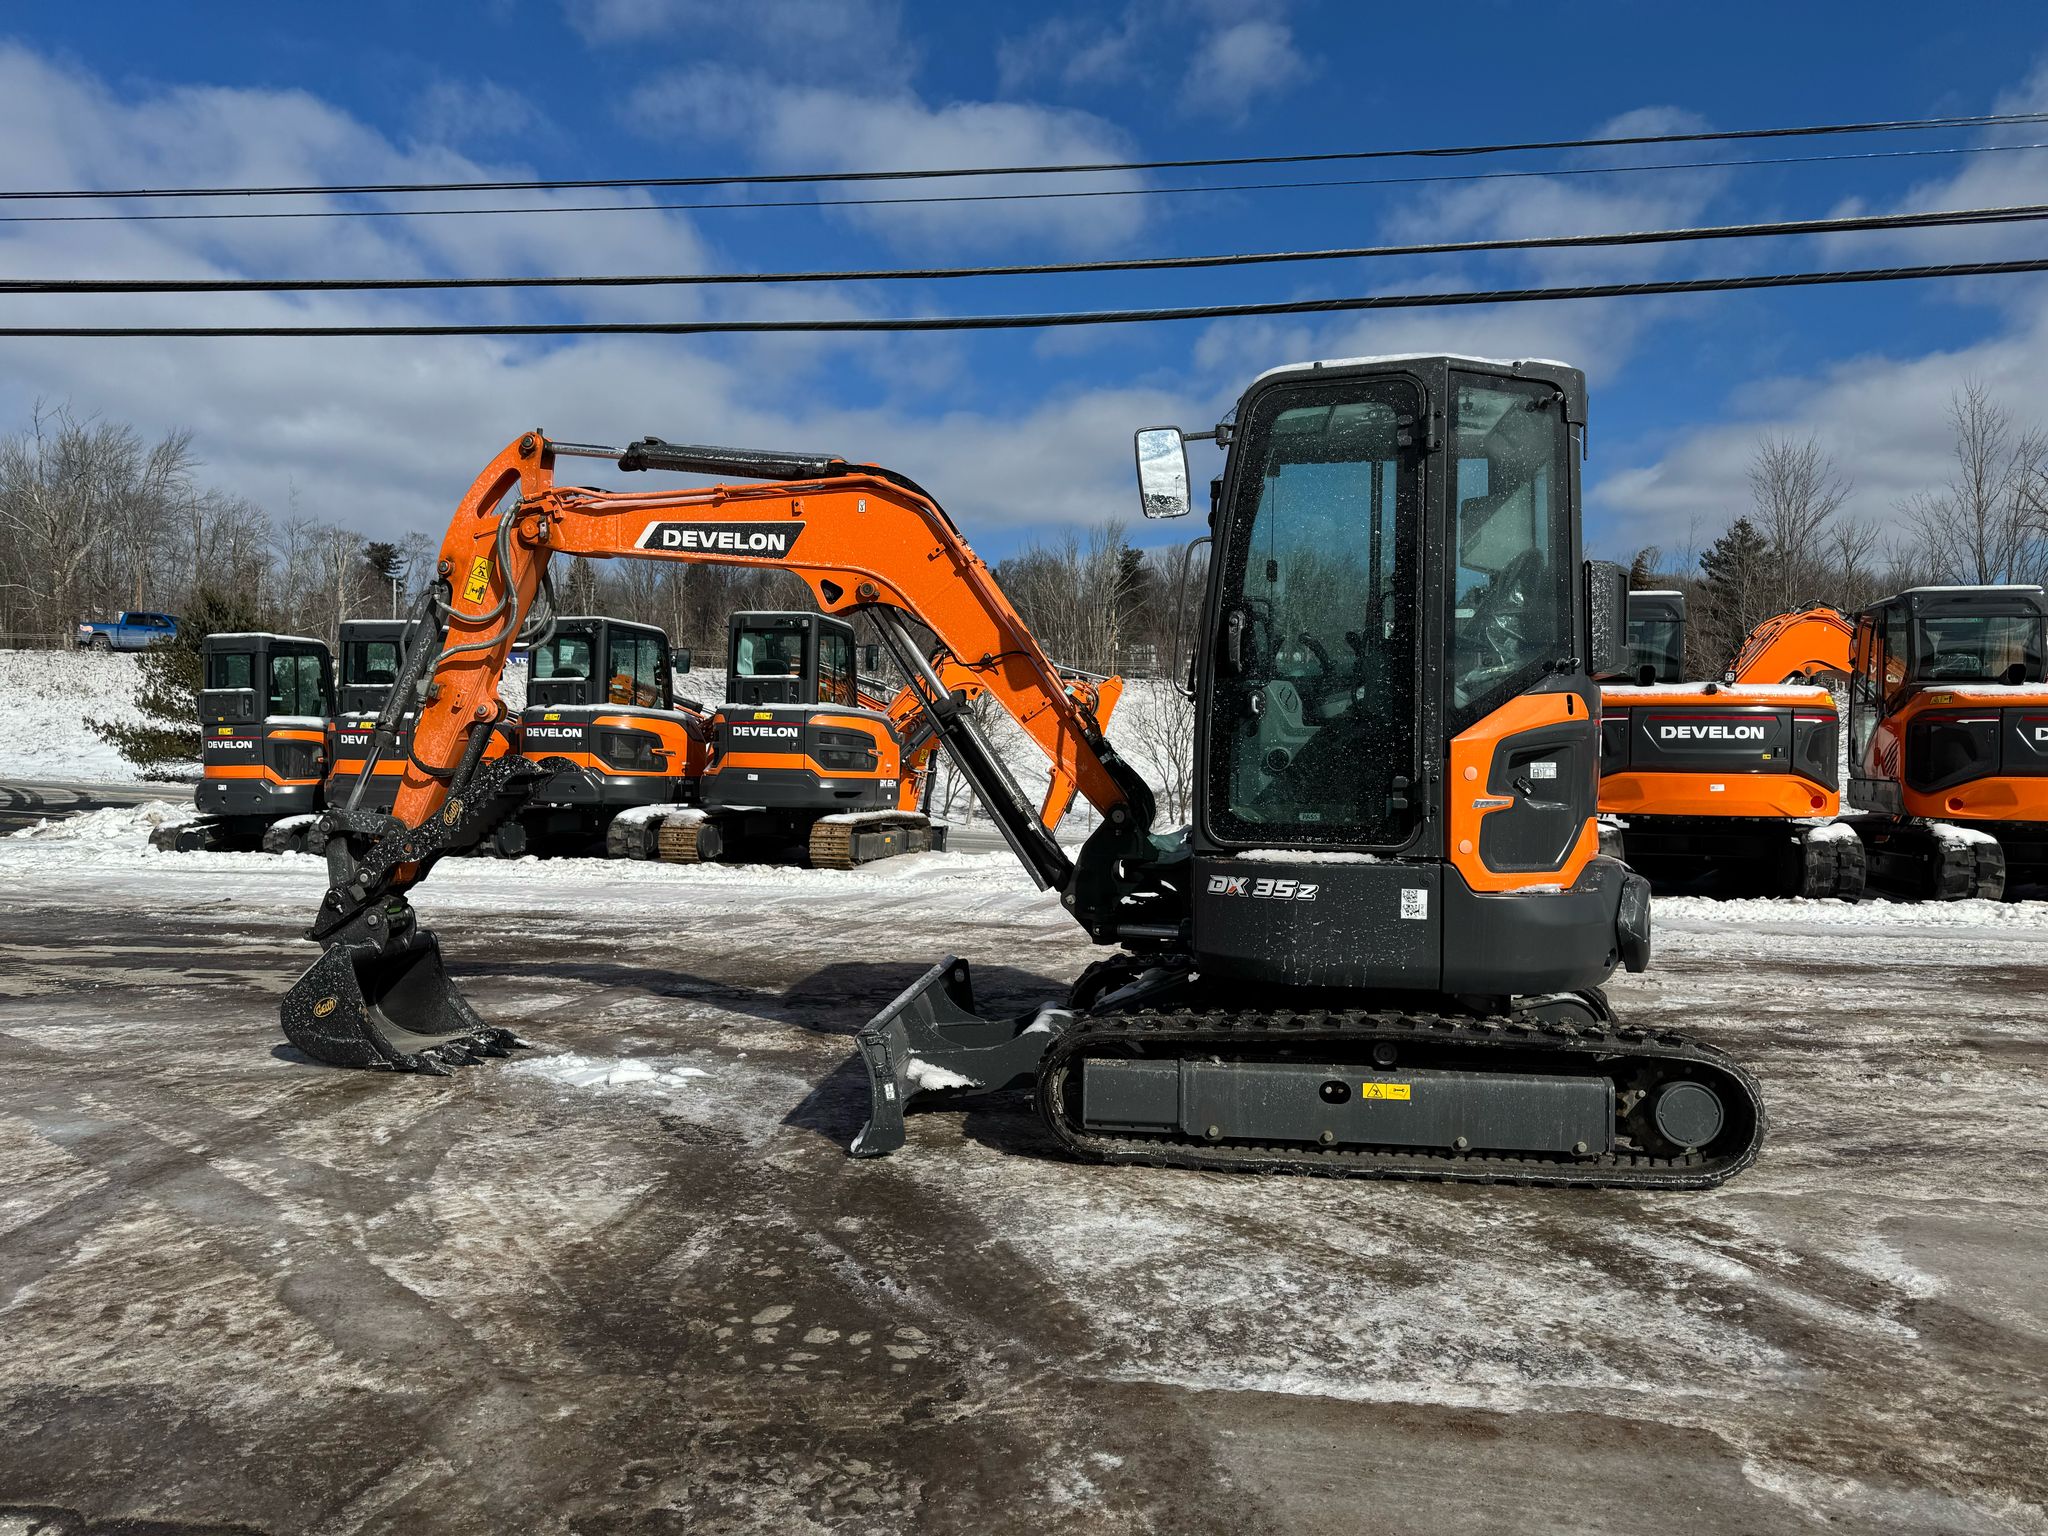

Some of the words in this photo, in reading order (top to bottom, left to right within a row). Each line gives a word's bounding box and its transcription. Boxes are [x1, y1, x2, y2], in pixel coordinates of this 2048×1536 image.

[662, 529, 786, 551] DEVELON
[526, 727, 582, 738] DEVELON
[732, 726, 798, 738] DEVELON
[1660, 725, 1765, 740] DEVELON
[207, 740, 253, 750] DEVELON
[1206, 874, 1250, 898] DX
